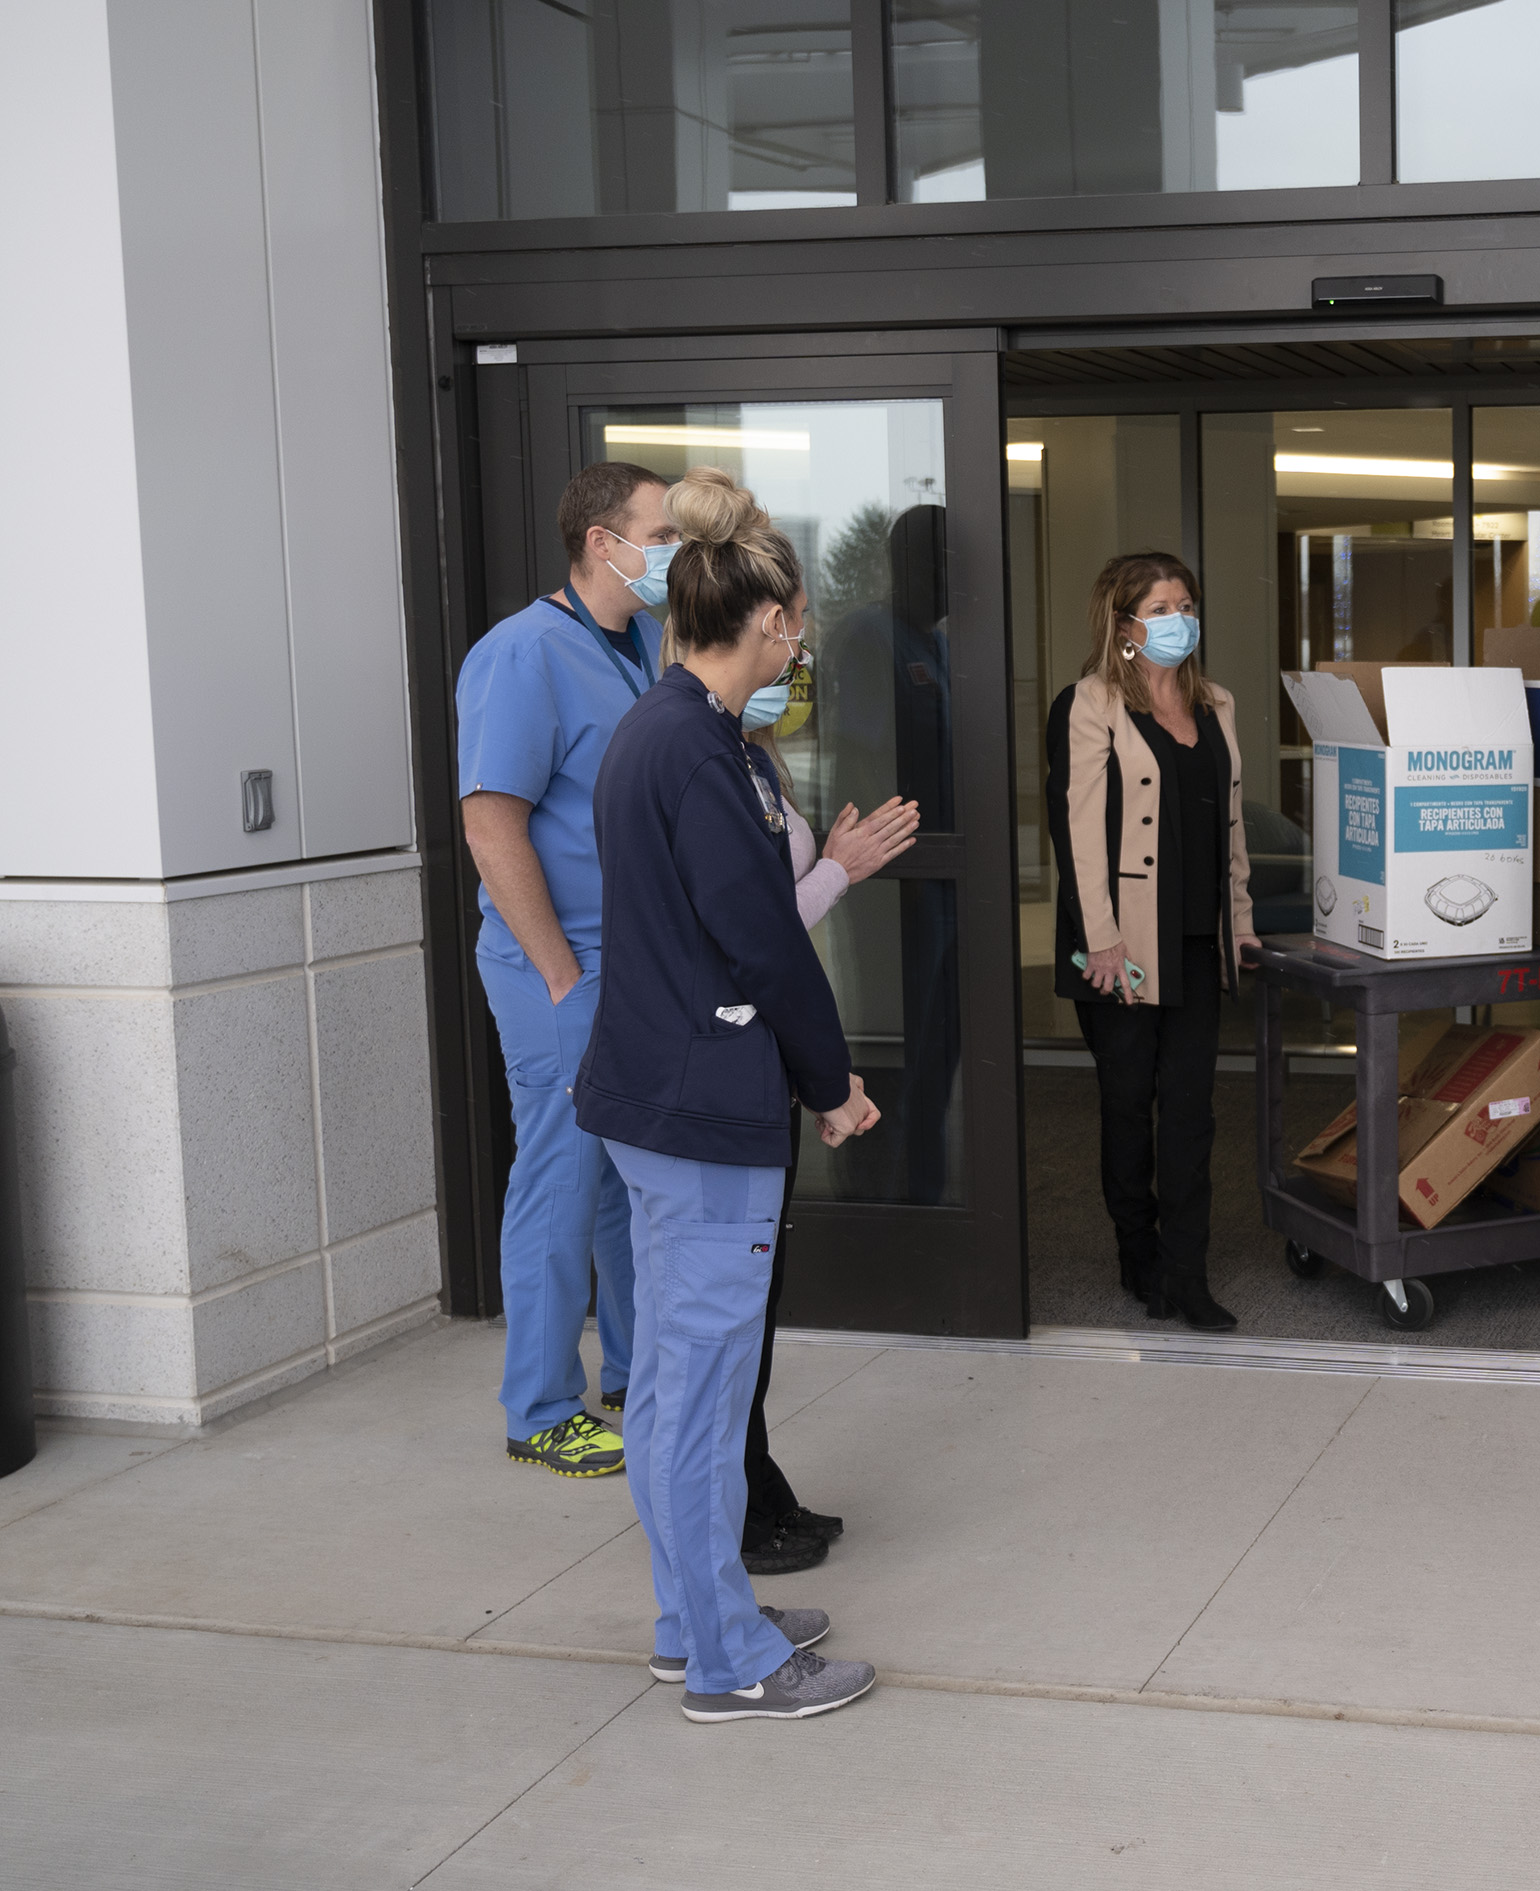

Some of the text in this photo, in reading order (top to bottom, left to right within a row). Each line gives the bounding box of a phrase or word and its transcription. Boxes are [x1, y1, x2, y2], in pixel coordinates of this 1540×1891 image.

[1408, 750, 1513, 772] MONOGRAM
[1345, 794, 1380, 815] RECIPIENTES
[1348, 811, 1376, 830] CON TAPA
[1420, 807, 1503, 820] RECIPIENTES CON
[1419, 818, 1504, 832] TAPA ARTICULADA
[1345, 828, 1380, 848] ARTICULADA
[1393, 940, 1399, 948] 2
[1428, 1194, 1440, 1207] UP
